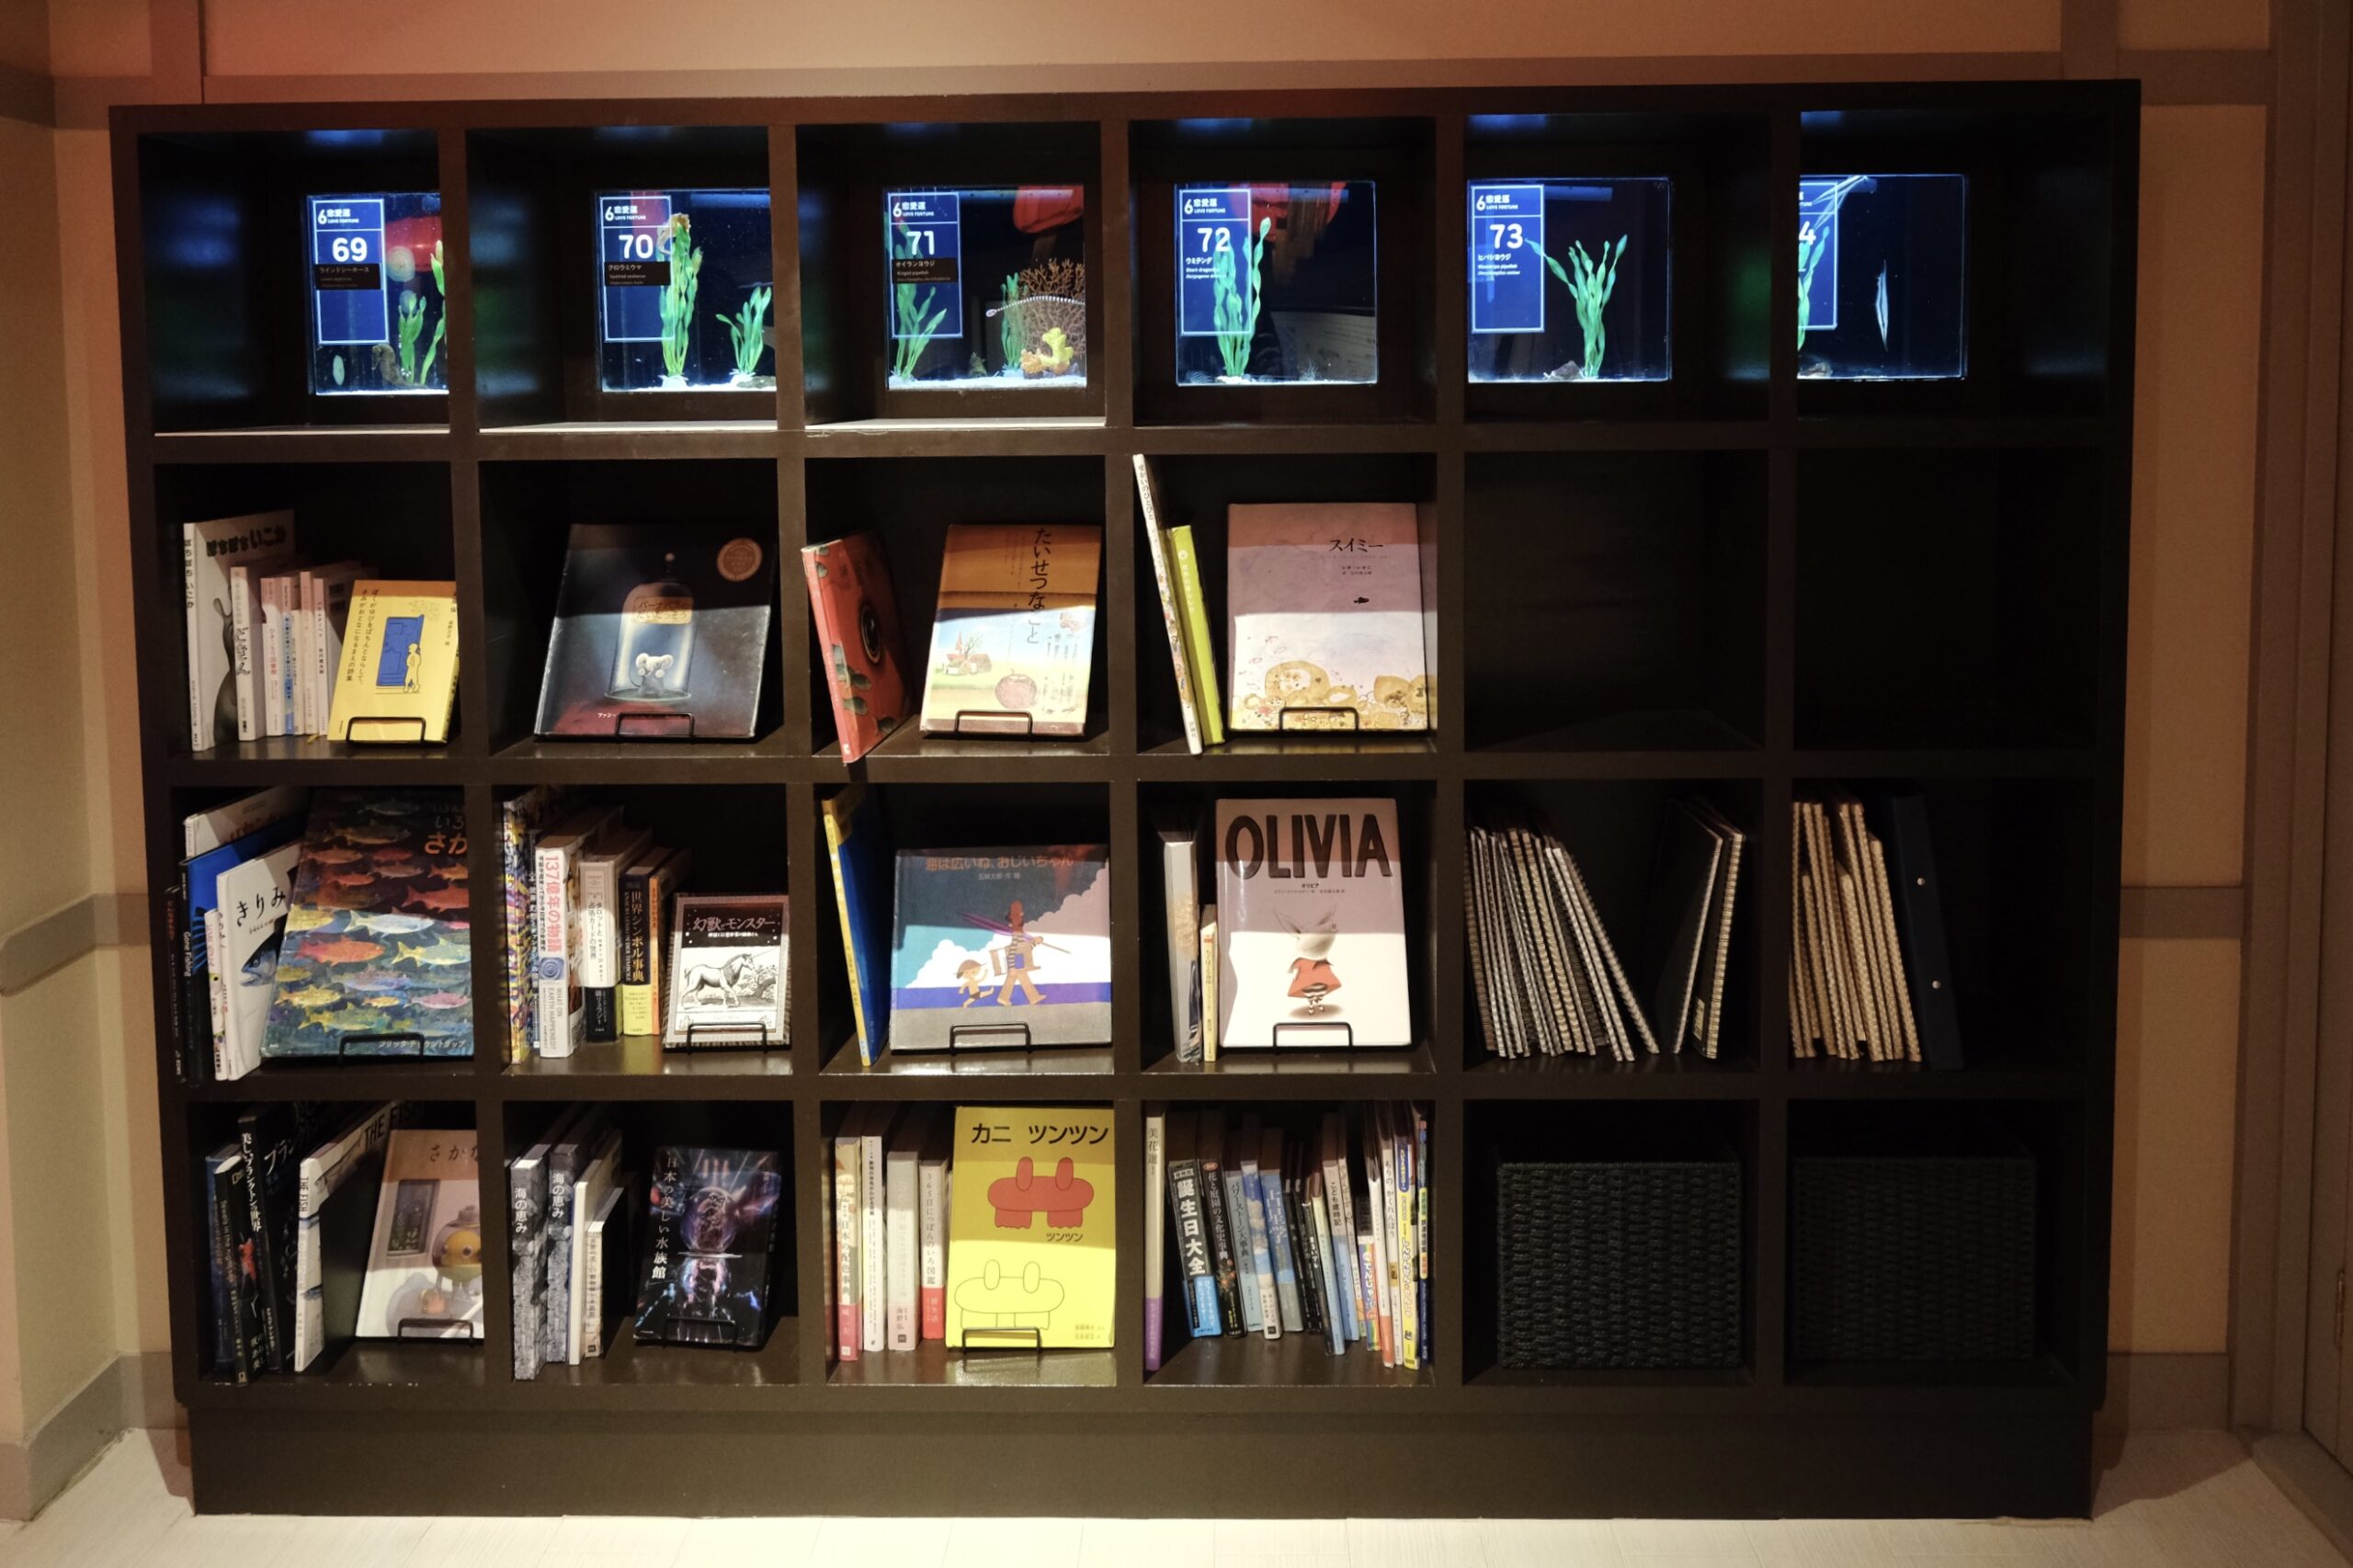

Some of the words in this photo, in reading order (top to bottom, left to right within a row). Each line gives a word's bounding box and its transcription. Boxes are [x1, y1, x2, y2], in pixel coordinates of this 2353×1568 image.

[332, 237, 368, 262] 69
[619, 233, 654, 259] 70
[906, 231, 935, 256] 71
[1197, 227, 1231, 252] 72
[1490, 223, 1523, 249] 73
[1329, 537, 1384, 552] スイミー
[1027, 527, 1052, 644] たいせつなこと
[1225, 813, 1394, 881] OLIVIA
[236, 886, 286, 927] きりみ
[545, 855, 563, 952] 137億年の物語
[183, 931, 192, 950] Gone
[631, 891, 645, 983] 世界シンボル事典
[364, 1113, 385, 1151] THE
[971, 1122, 1012, 1144] カニ
[1029, 1123, 1109, 1145] ツンツン
[1147, 1127, 1159, 1164] 美花選
[300, 1176, 310, 1190] THE
[551, 1172, 565, 1218] 海の恵み
[300, 1194, 309, 1212] FISH
[515, 1187, 528, 1233] 海の恵み
[651, 1156, 677, 1279] 日本の美しい水族館
[1046, 1232, 1084, 1243] ツンツン
[1176, 1178, 1206, 1275] 誕生日大全
